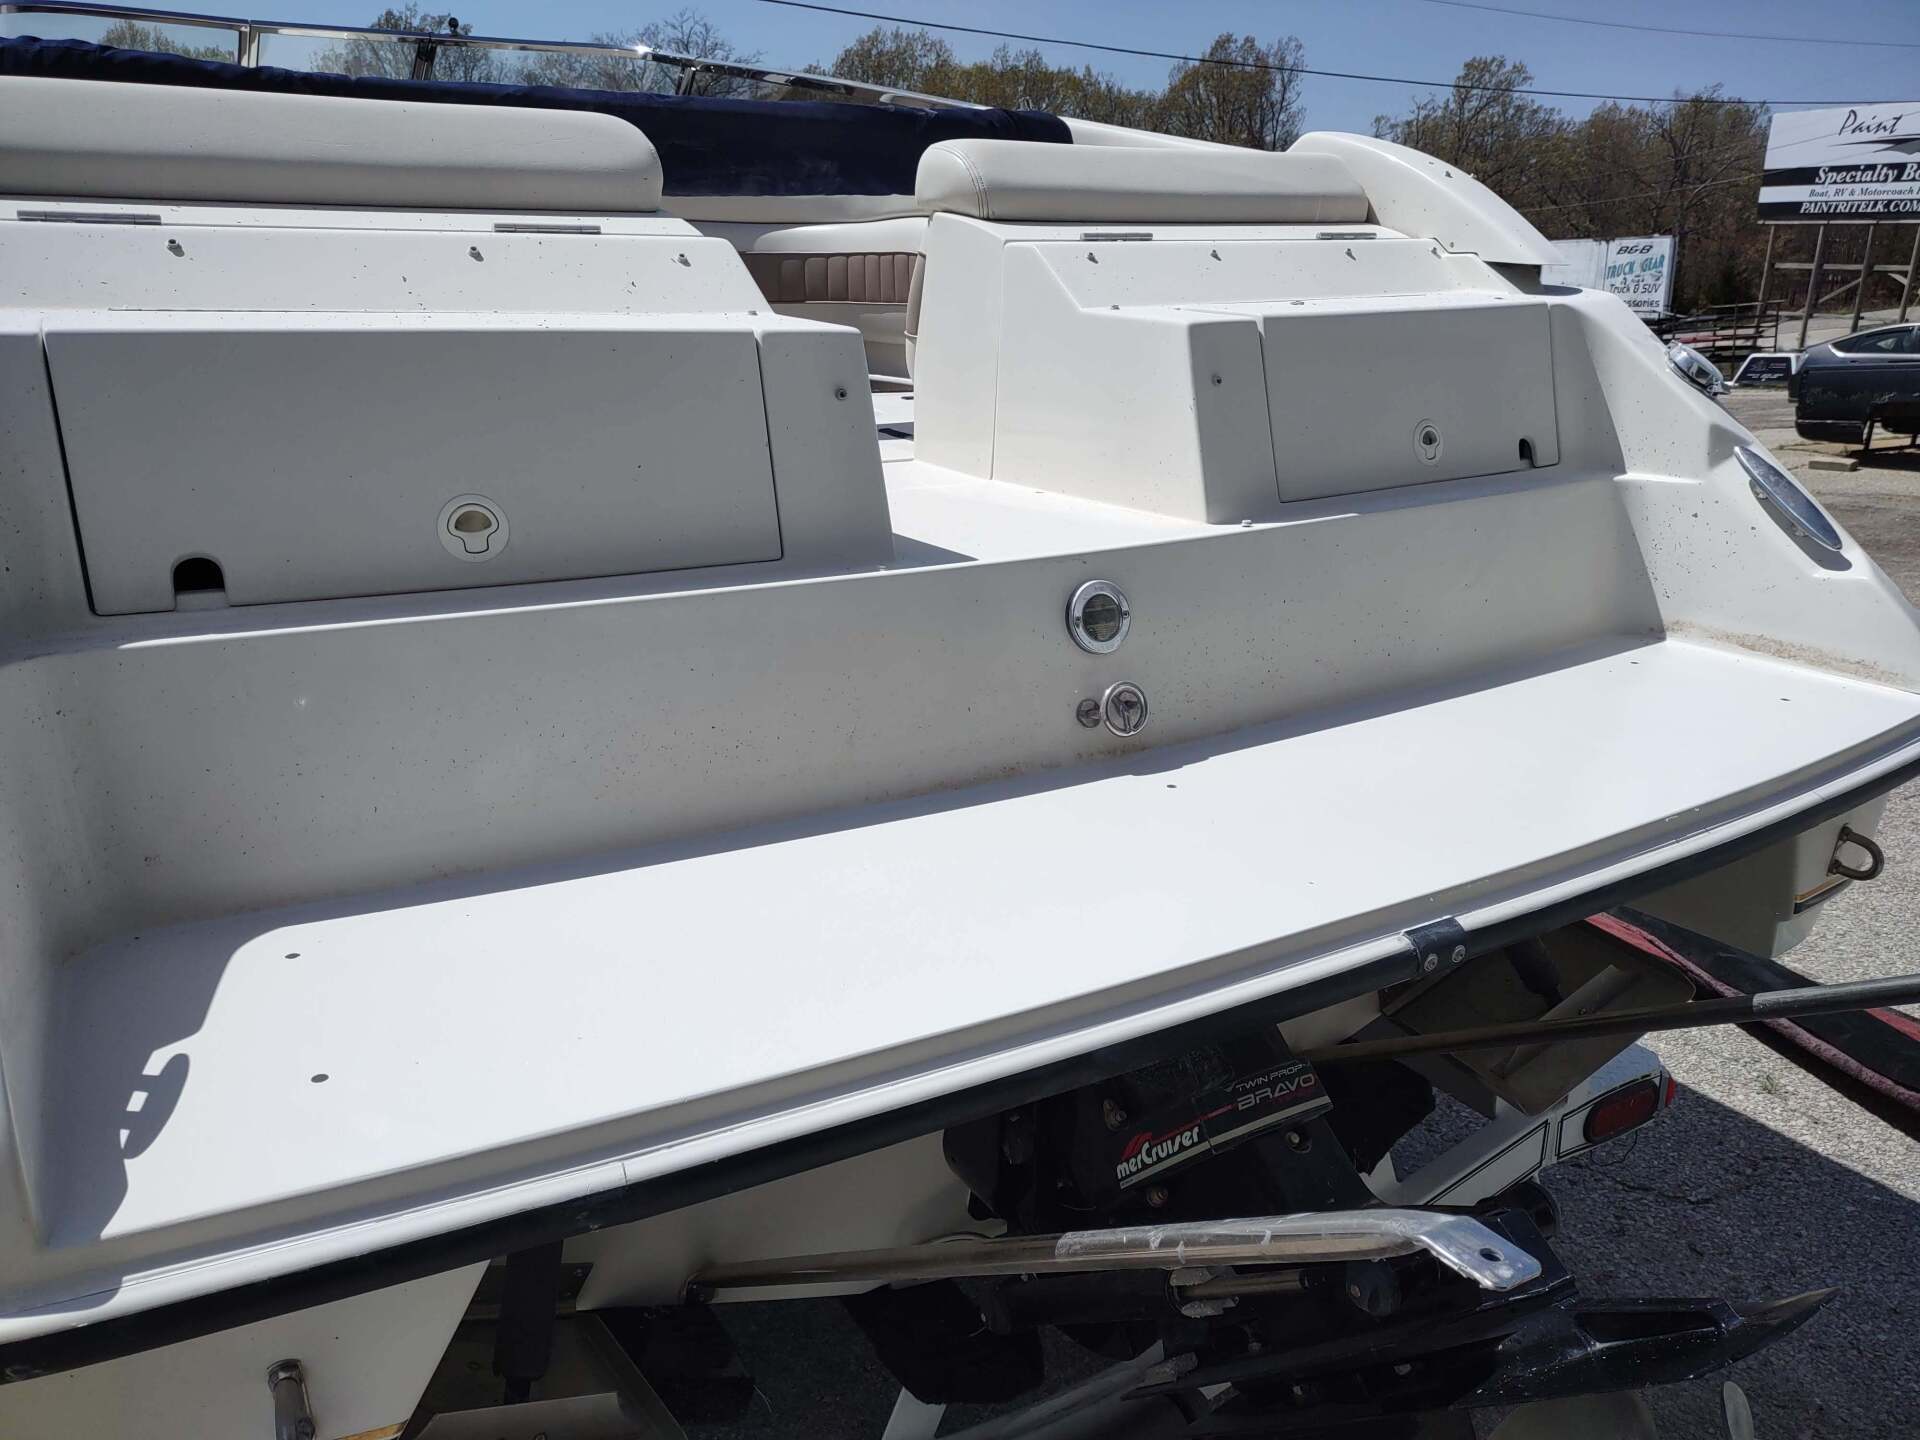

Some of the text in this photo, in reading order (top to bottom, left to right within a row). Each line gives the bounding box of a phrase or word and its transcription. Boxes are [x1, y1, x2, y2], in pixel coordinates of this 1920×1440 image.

[1838, 109, 1903, 136] Paint
[1815, 165, 1898, 188] Specialty
[1808, 189, 1830, 199] Boat,
[1834, 188, 1849, 197] RV
[1848, 188, 1856, 197] &
[1857, 186, 1914, 197] Motorcoach
[1616, 245, 1653, 255] B&B
[1606, 254, 1665, 280] TRUCK GEAR
[1610, 284, 1630, 294] Truck
[1641, 283, 1661, 294] SUV
[1624, 298, 1660, 308] ssories
[1235, 1064, 1303, 1092] TWIN PROP
[1237, 1073, 1315, 1111] BRAVO
